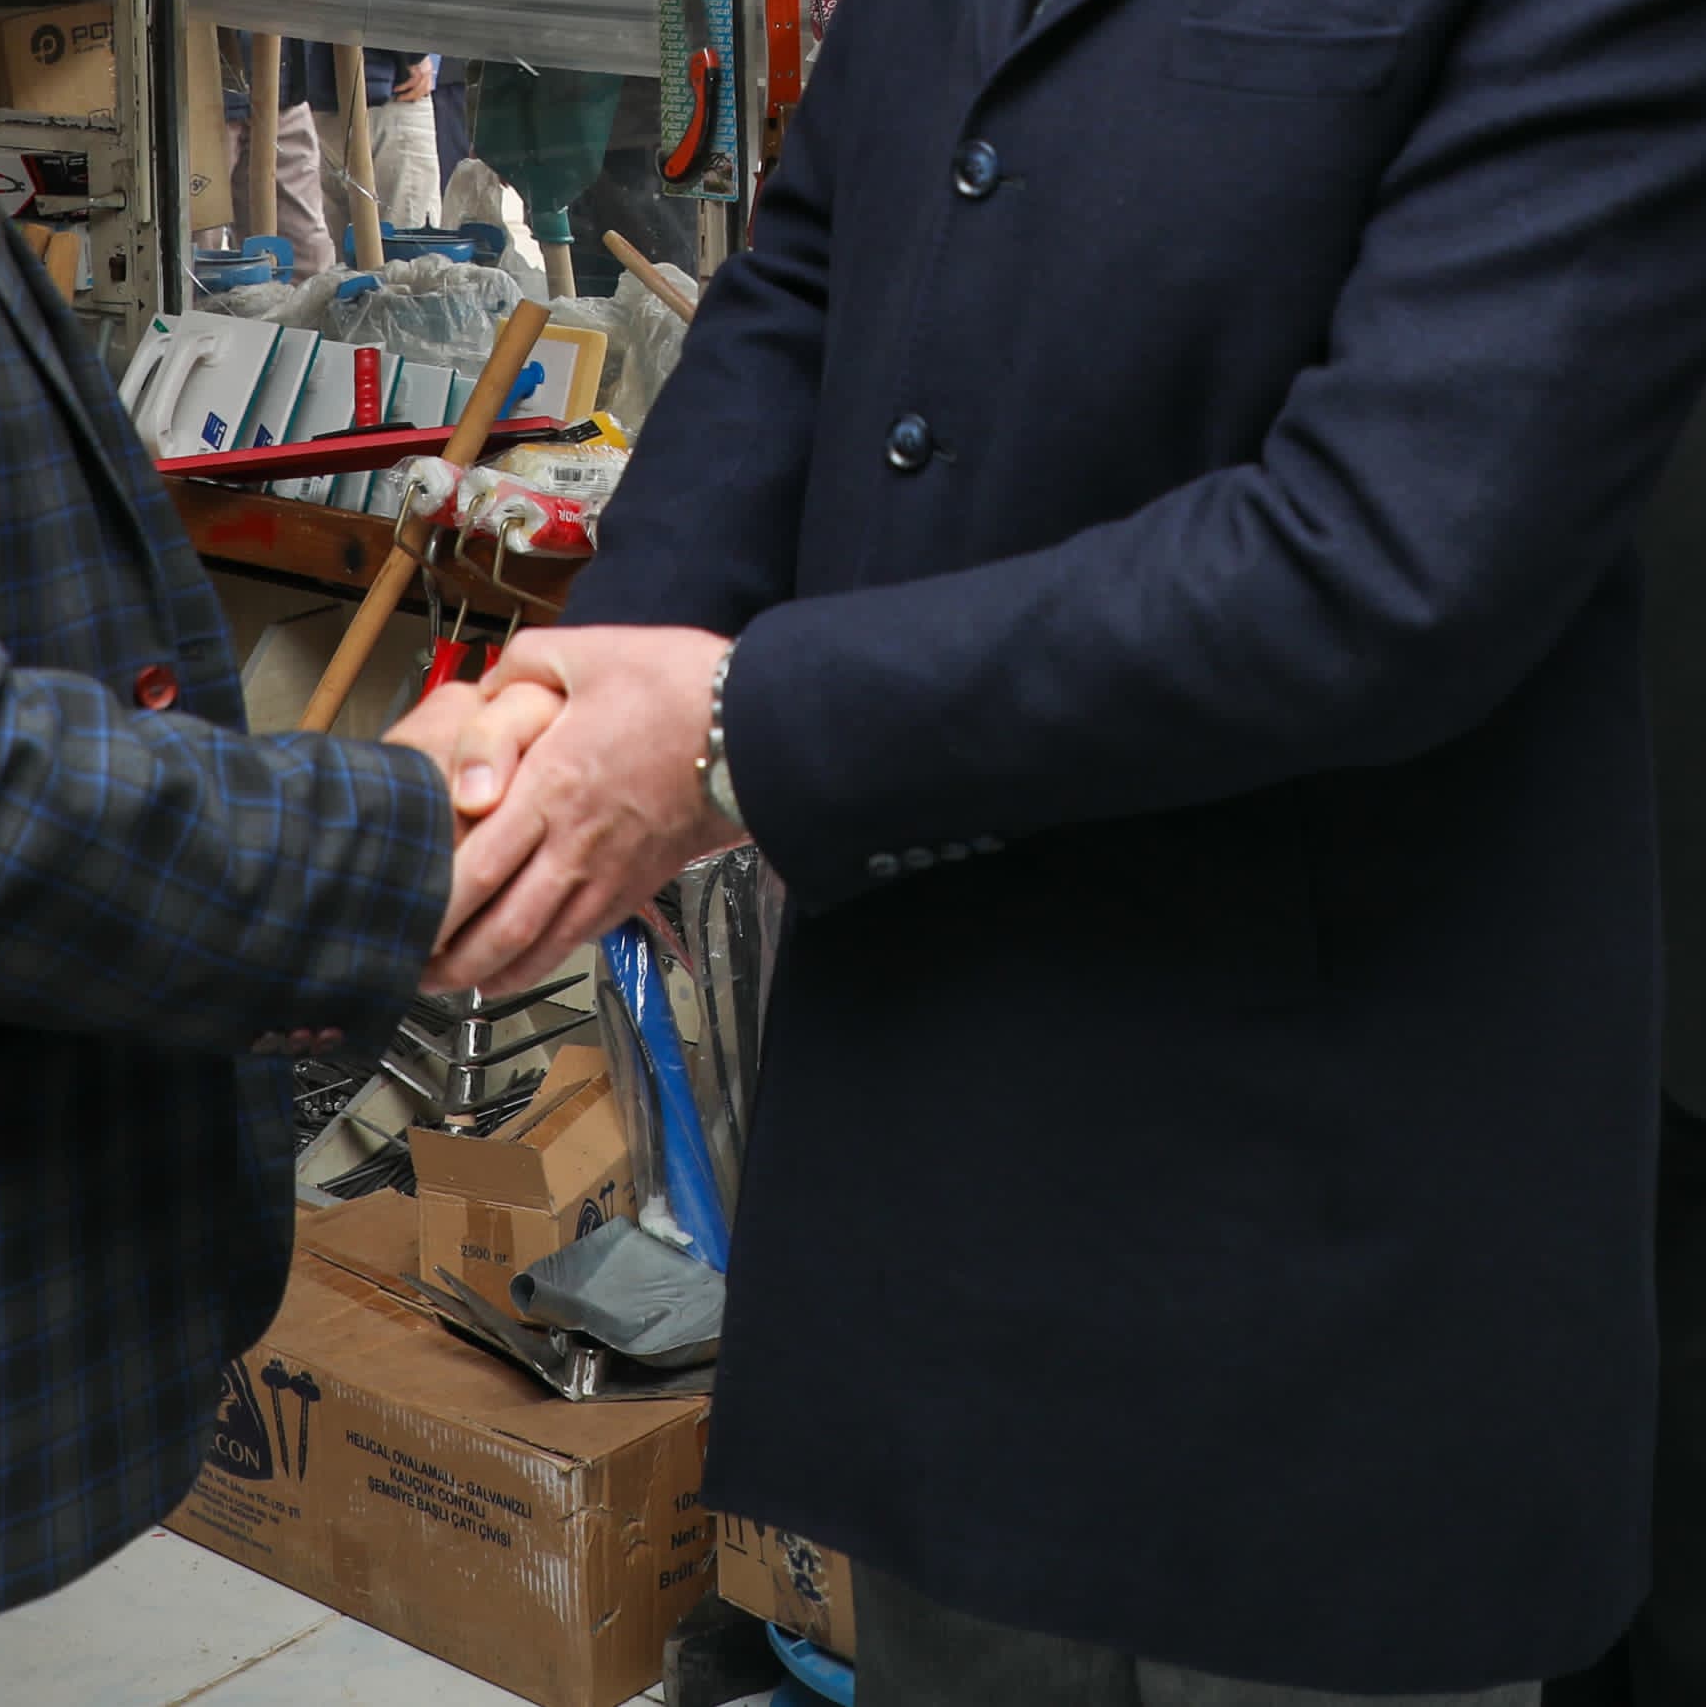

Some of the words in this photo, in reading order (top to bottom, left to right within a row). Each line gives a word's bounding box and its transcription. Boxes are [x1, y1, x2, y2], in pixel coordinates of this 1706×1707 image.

[461, 1243, 490, 1261] 2500
[210, 1433, 261, 1471] CON
[389, 1467, 434, 1496] KAUÇUK
[368, 1475, 415, 1508] ŞEMSİYE
[416, 1496, 449, 1522] BAŞLI
[451, 1512, 476, 1535] ÇATI
